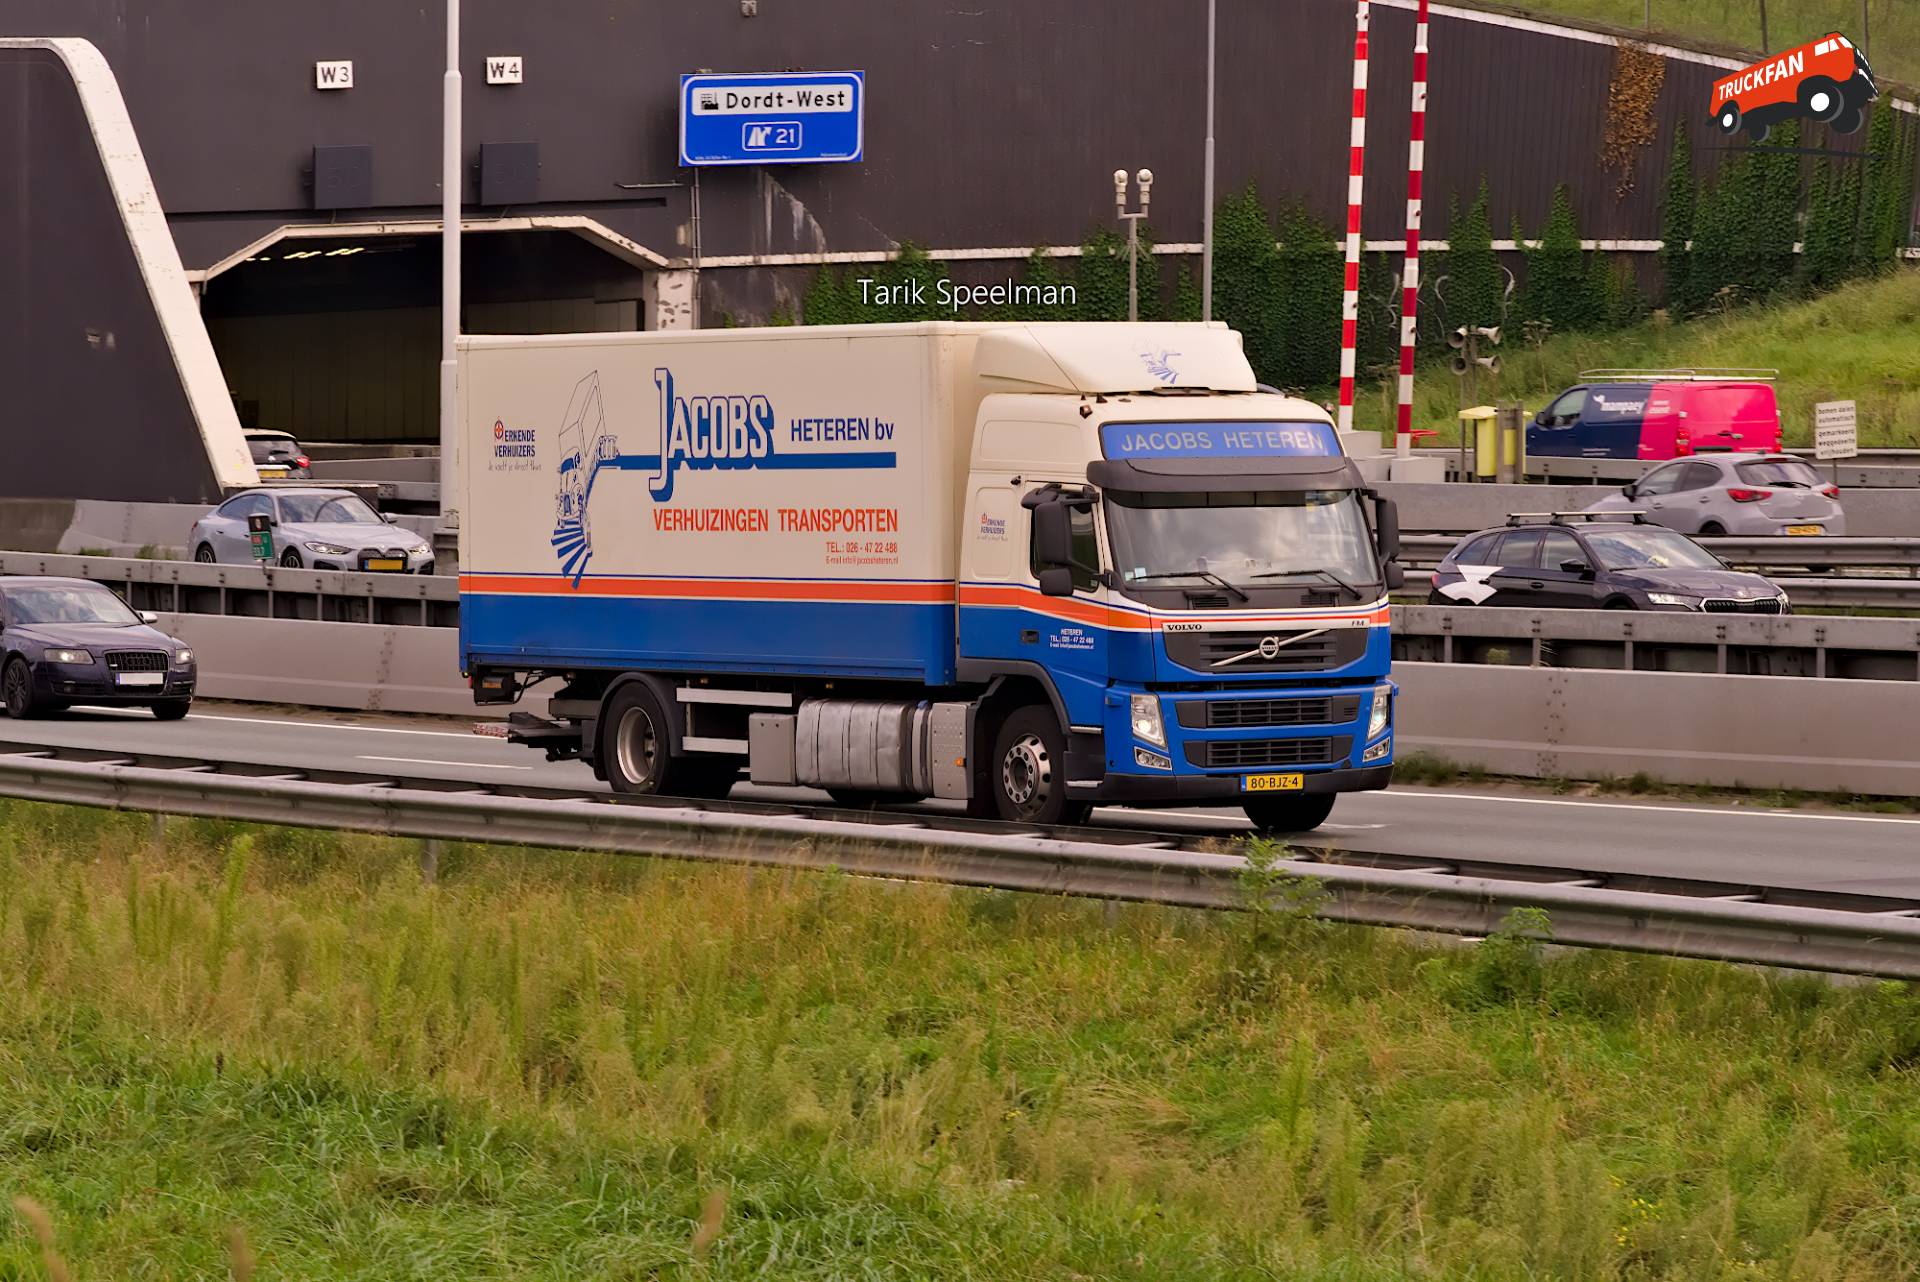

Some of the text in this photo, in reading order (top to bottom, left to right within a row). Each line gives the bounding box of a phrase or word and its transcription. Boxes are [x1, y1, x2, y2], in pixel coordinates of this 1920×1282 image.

[726, 91, 845, 109] Dordt-West
[775, 128, 795, 144] 21
[505, 429, 536, 442] ERKENDE
[791, 418, 869, 441] HETEREN
[874, 417, 894, 440] bv
[1121, 430, 1324, 452] JACOBS HETEREN
[494, 445, 536, 458] VERHUIZERS
[653, 508, 898, 532] VERHUIZINGEN TRANSPORTEN
[846, 542, 858, 553] 026
[864, 542, 873, 553] 47
[874, 542, 883, 553] 22
[1251, 776, 1299, 789] 80-BJZ-4
